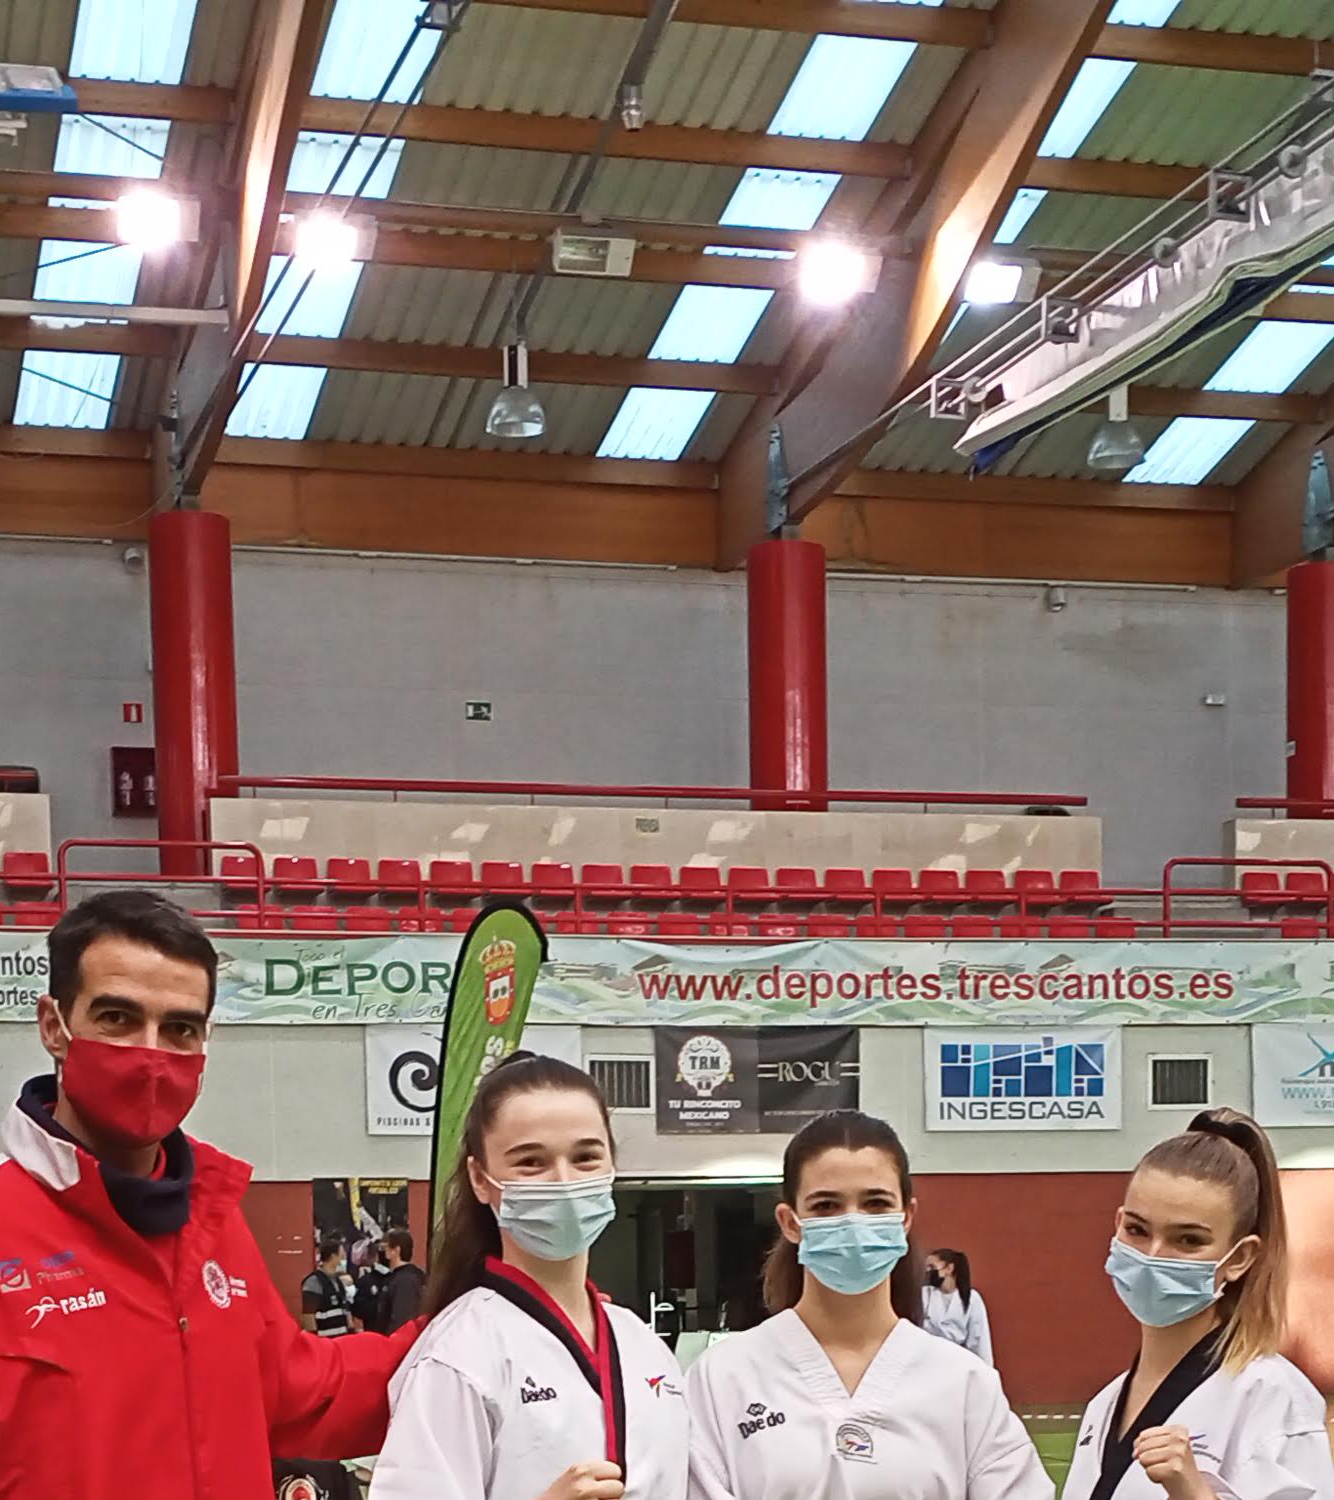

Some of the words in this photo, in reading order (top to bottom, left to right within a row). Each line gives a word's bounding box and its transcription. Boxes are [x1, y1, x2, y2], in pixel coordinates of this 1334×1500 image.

[264, 958, 450, 998] DEPOR
[637, 965, 1236, 1008] www.deportes.trescantos.es
[313, 1005, 337, 1020] en
[353, 994, 396, 1018] Tres
[689, 1056, 721, 1070] TRM
[668, 1100, 681, 1110] TU
[939, 1100, 1105, 1120] INGESCASA
[679, 1111, 730, 1121] MEXICANO
